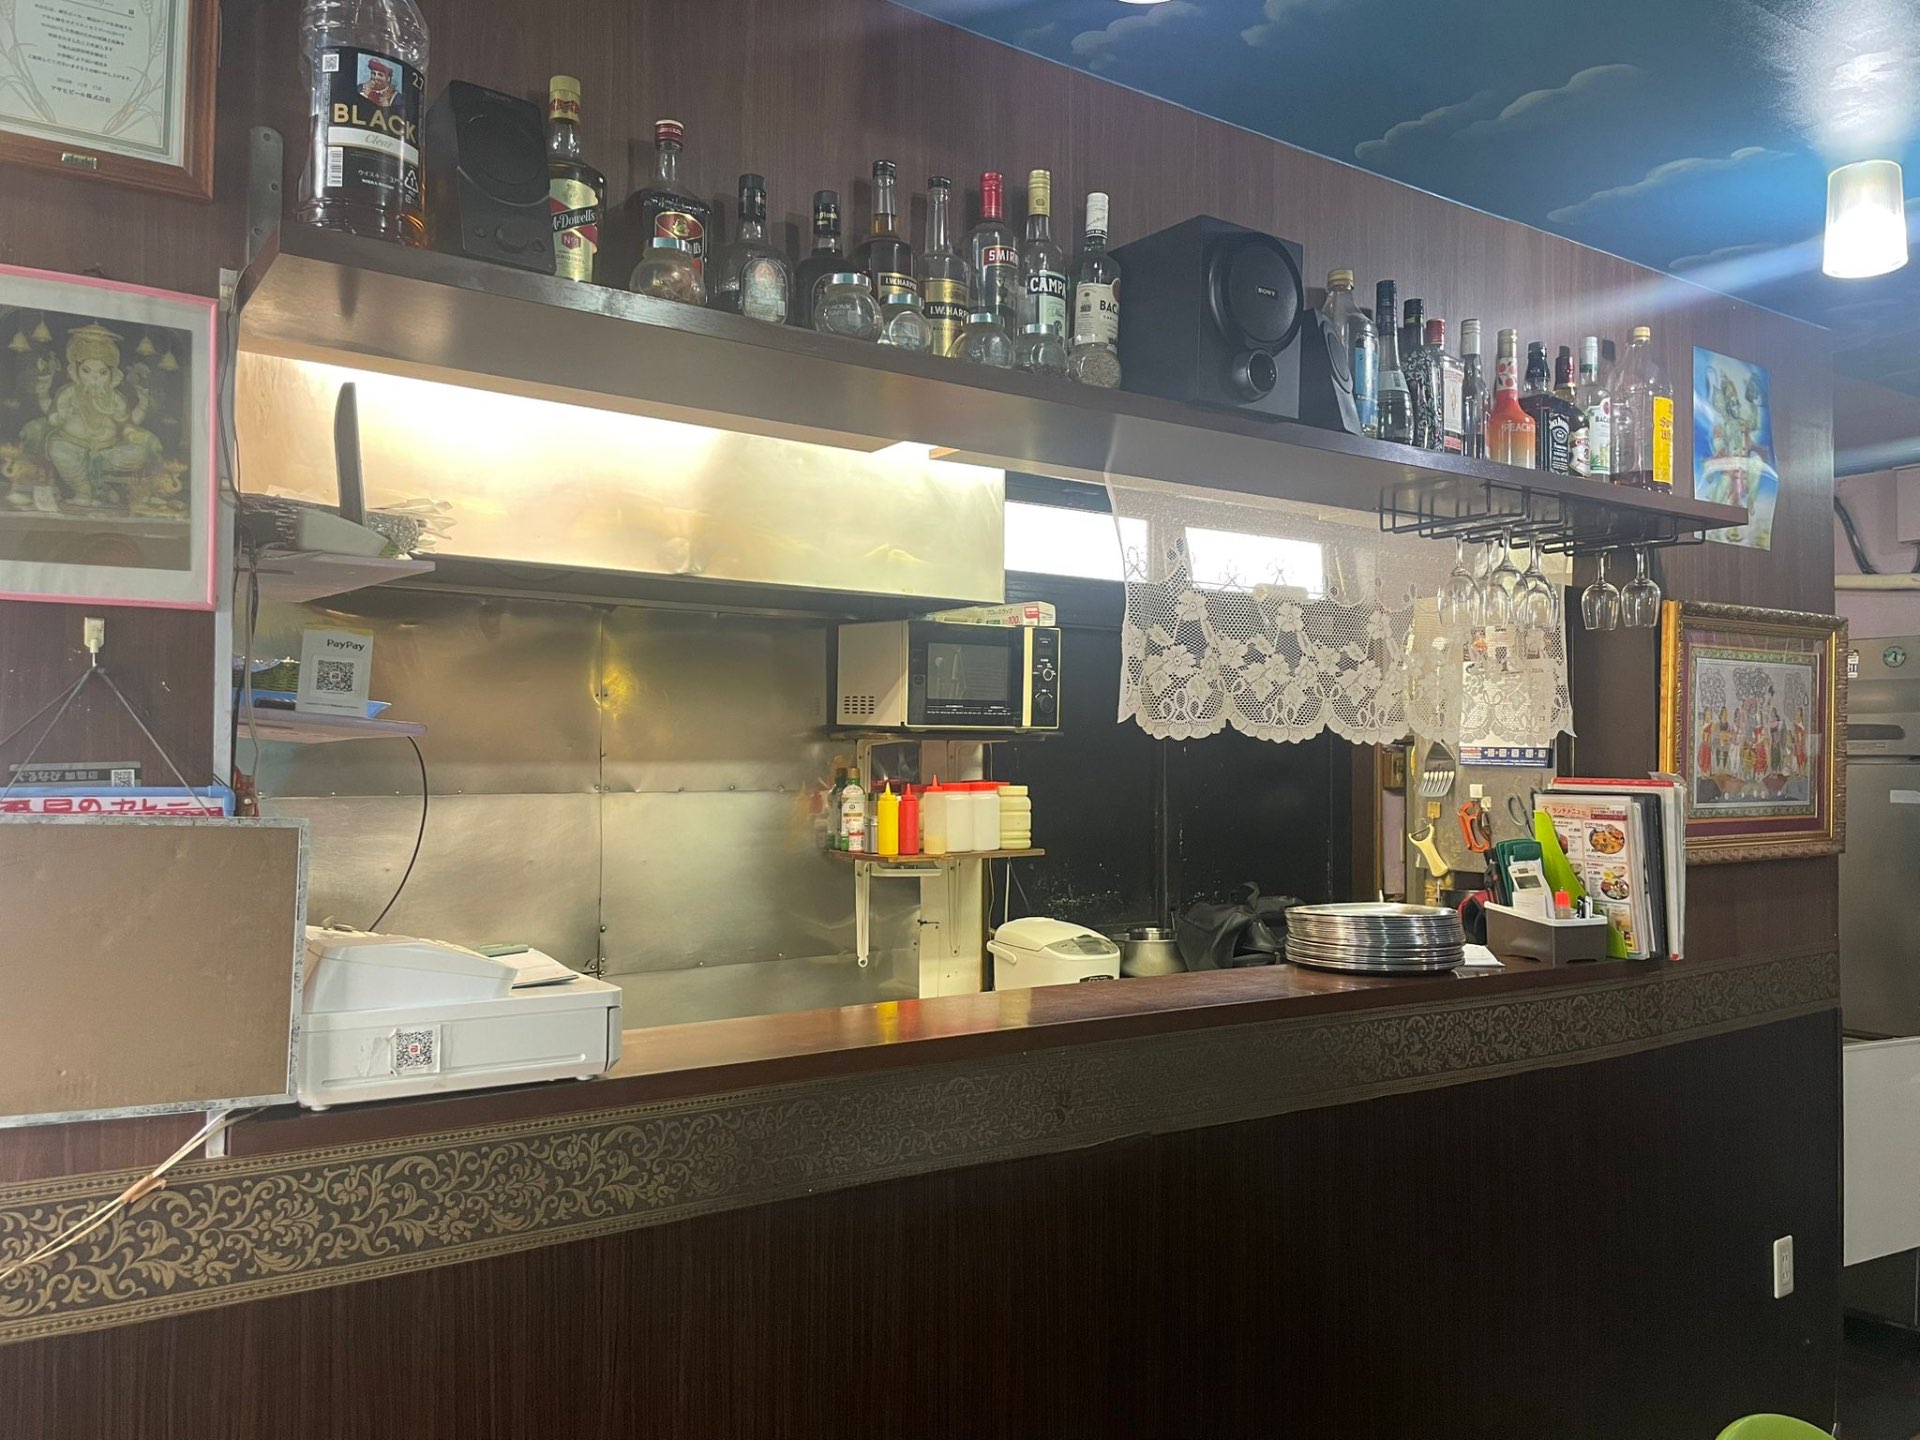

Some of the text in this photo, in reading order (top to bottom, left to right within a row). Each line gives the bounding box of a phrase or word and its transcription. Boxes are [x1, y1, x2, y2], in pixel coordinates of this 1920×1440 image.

[334, 103, 416, 143] BLACK
[365, 133, 394, 149] Clear
[1258, 287, 1275, 296] SONY
[326, 638, 365, 652] PayPay
[17, 770, 63, 782] ぐるなび
